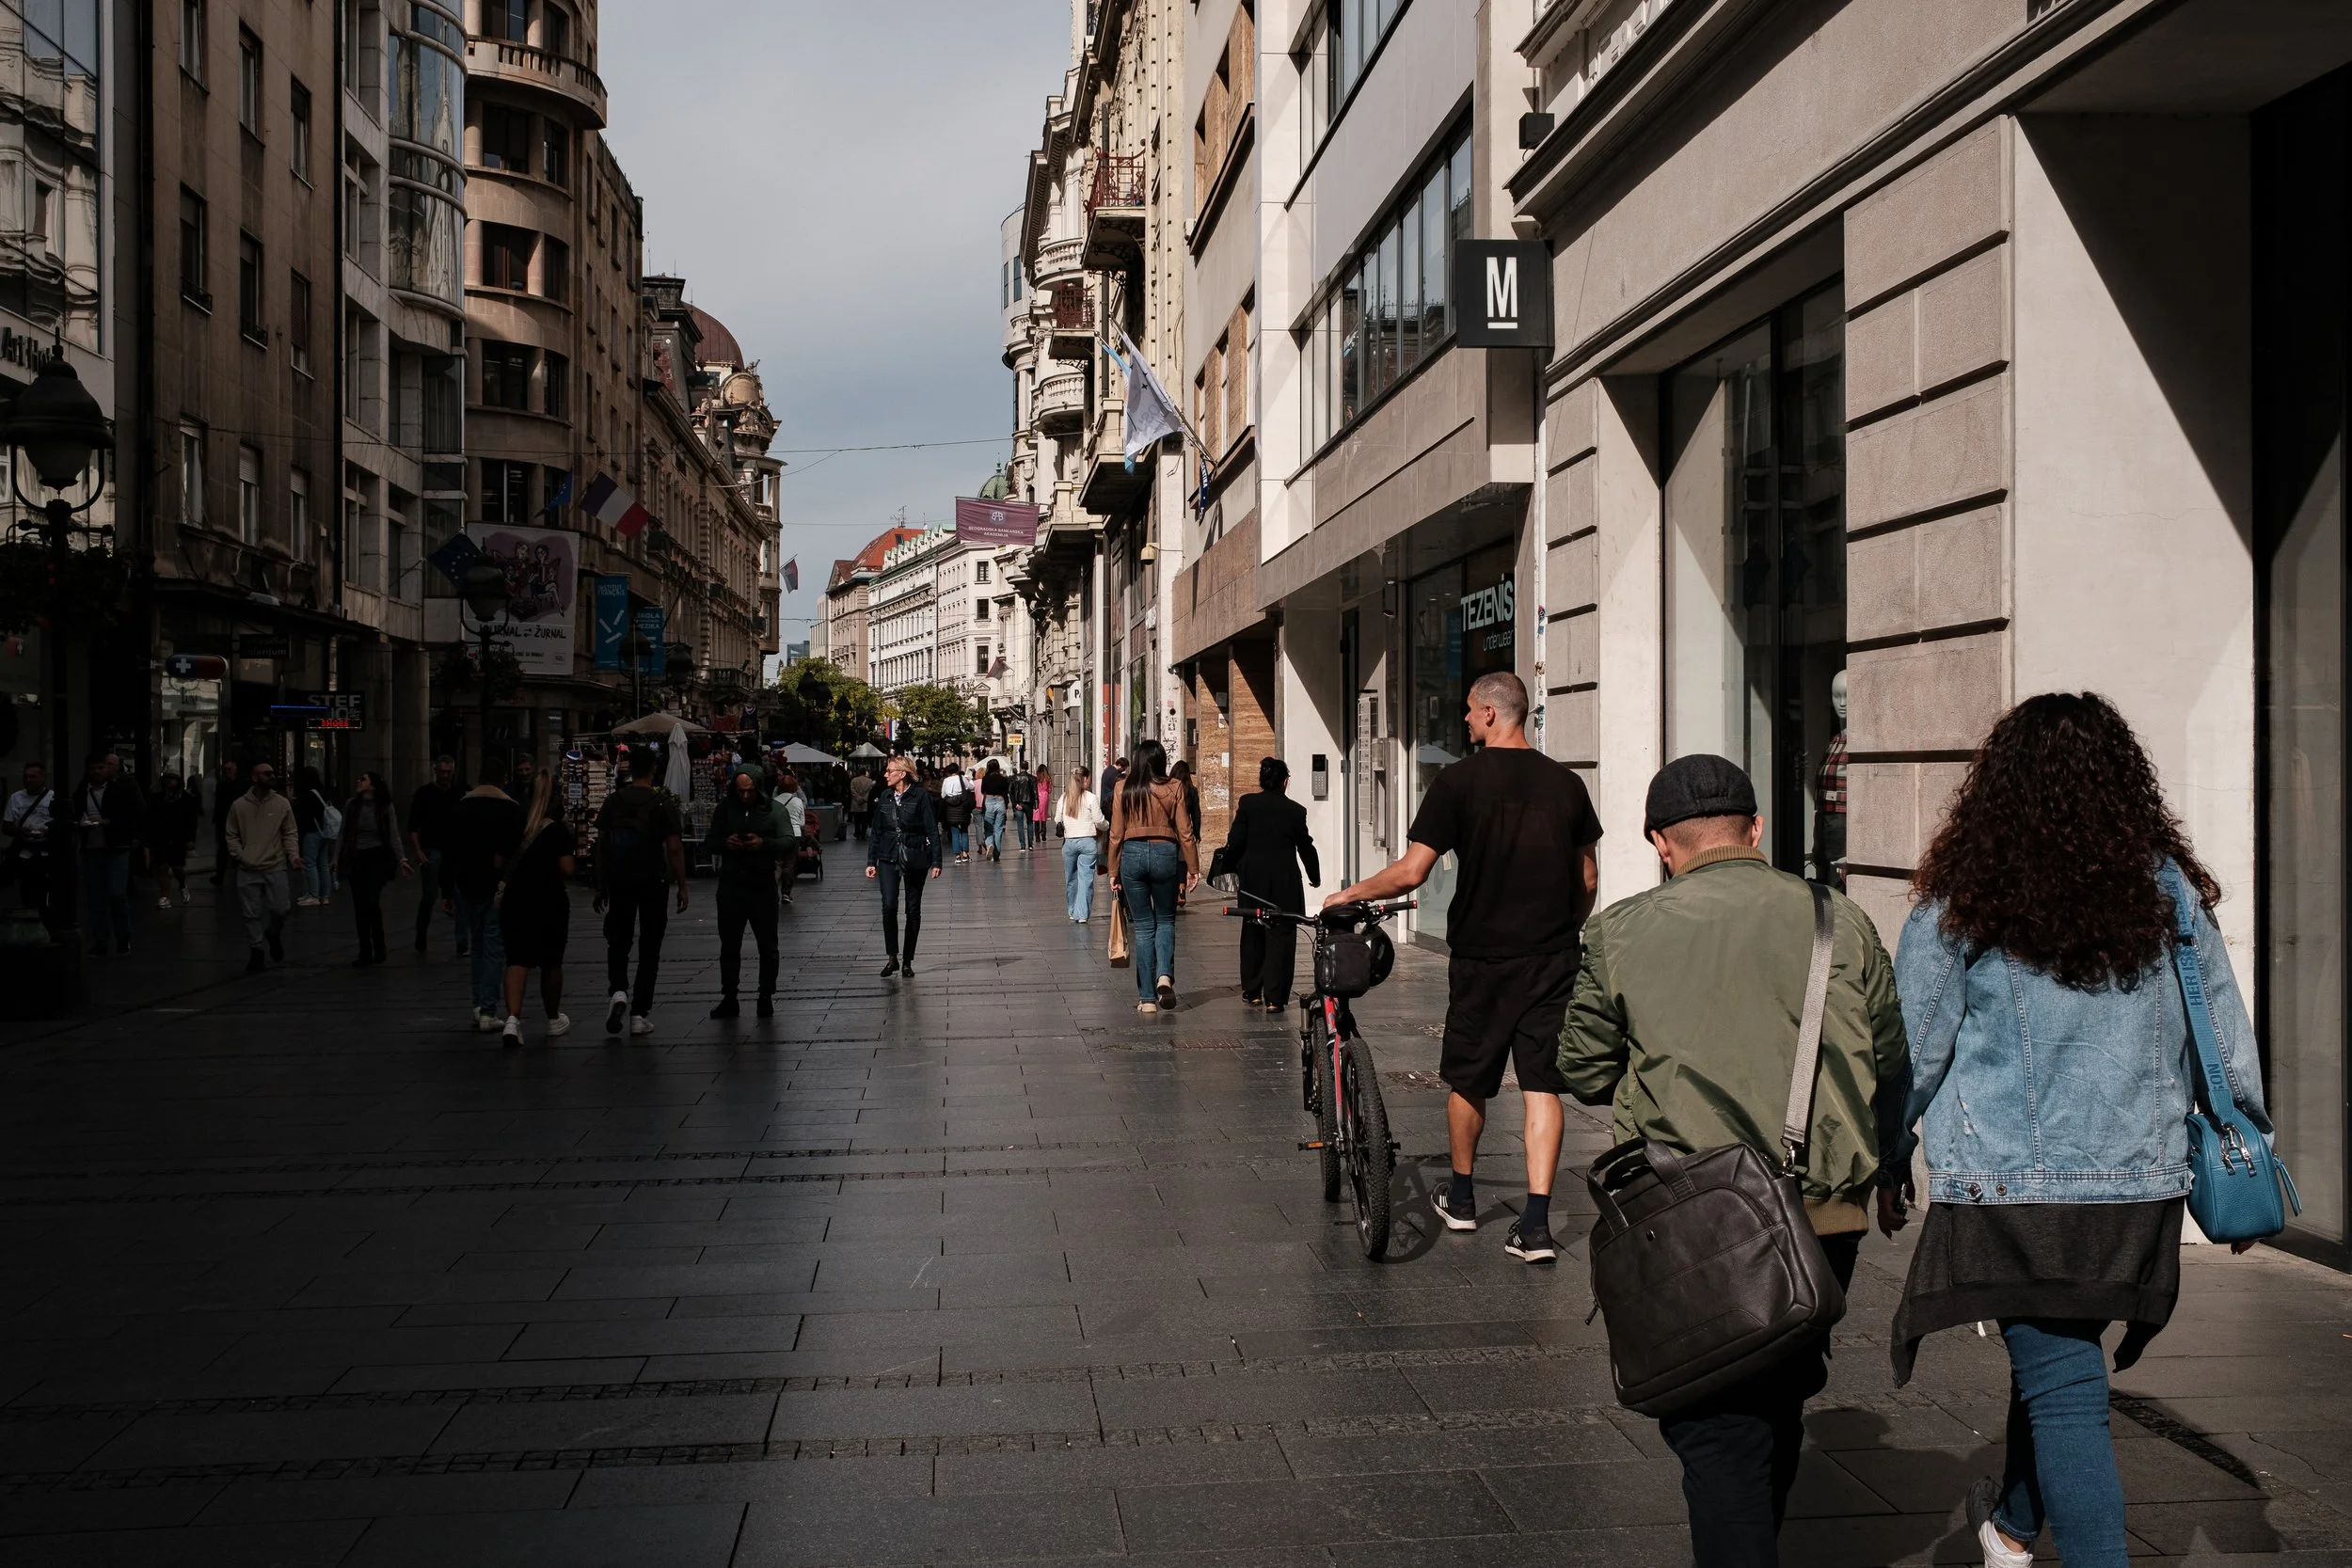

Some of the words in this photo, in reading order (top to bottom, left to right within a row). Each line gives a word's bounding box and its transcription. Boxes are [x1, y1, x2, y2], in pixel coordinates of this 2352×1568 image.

[1486, 256, 1518, 318] M
[533, 625, 566, 640] ŽURNAL
[1483, 629, 1514, 652] underwear
[308, 694, 361, 707] STEF
